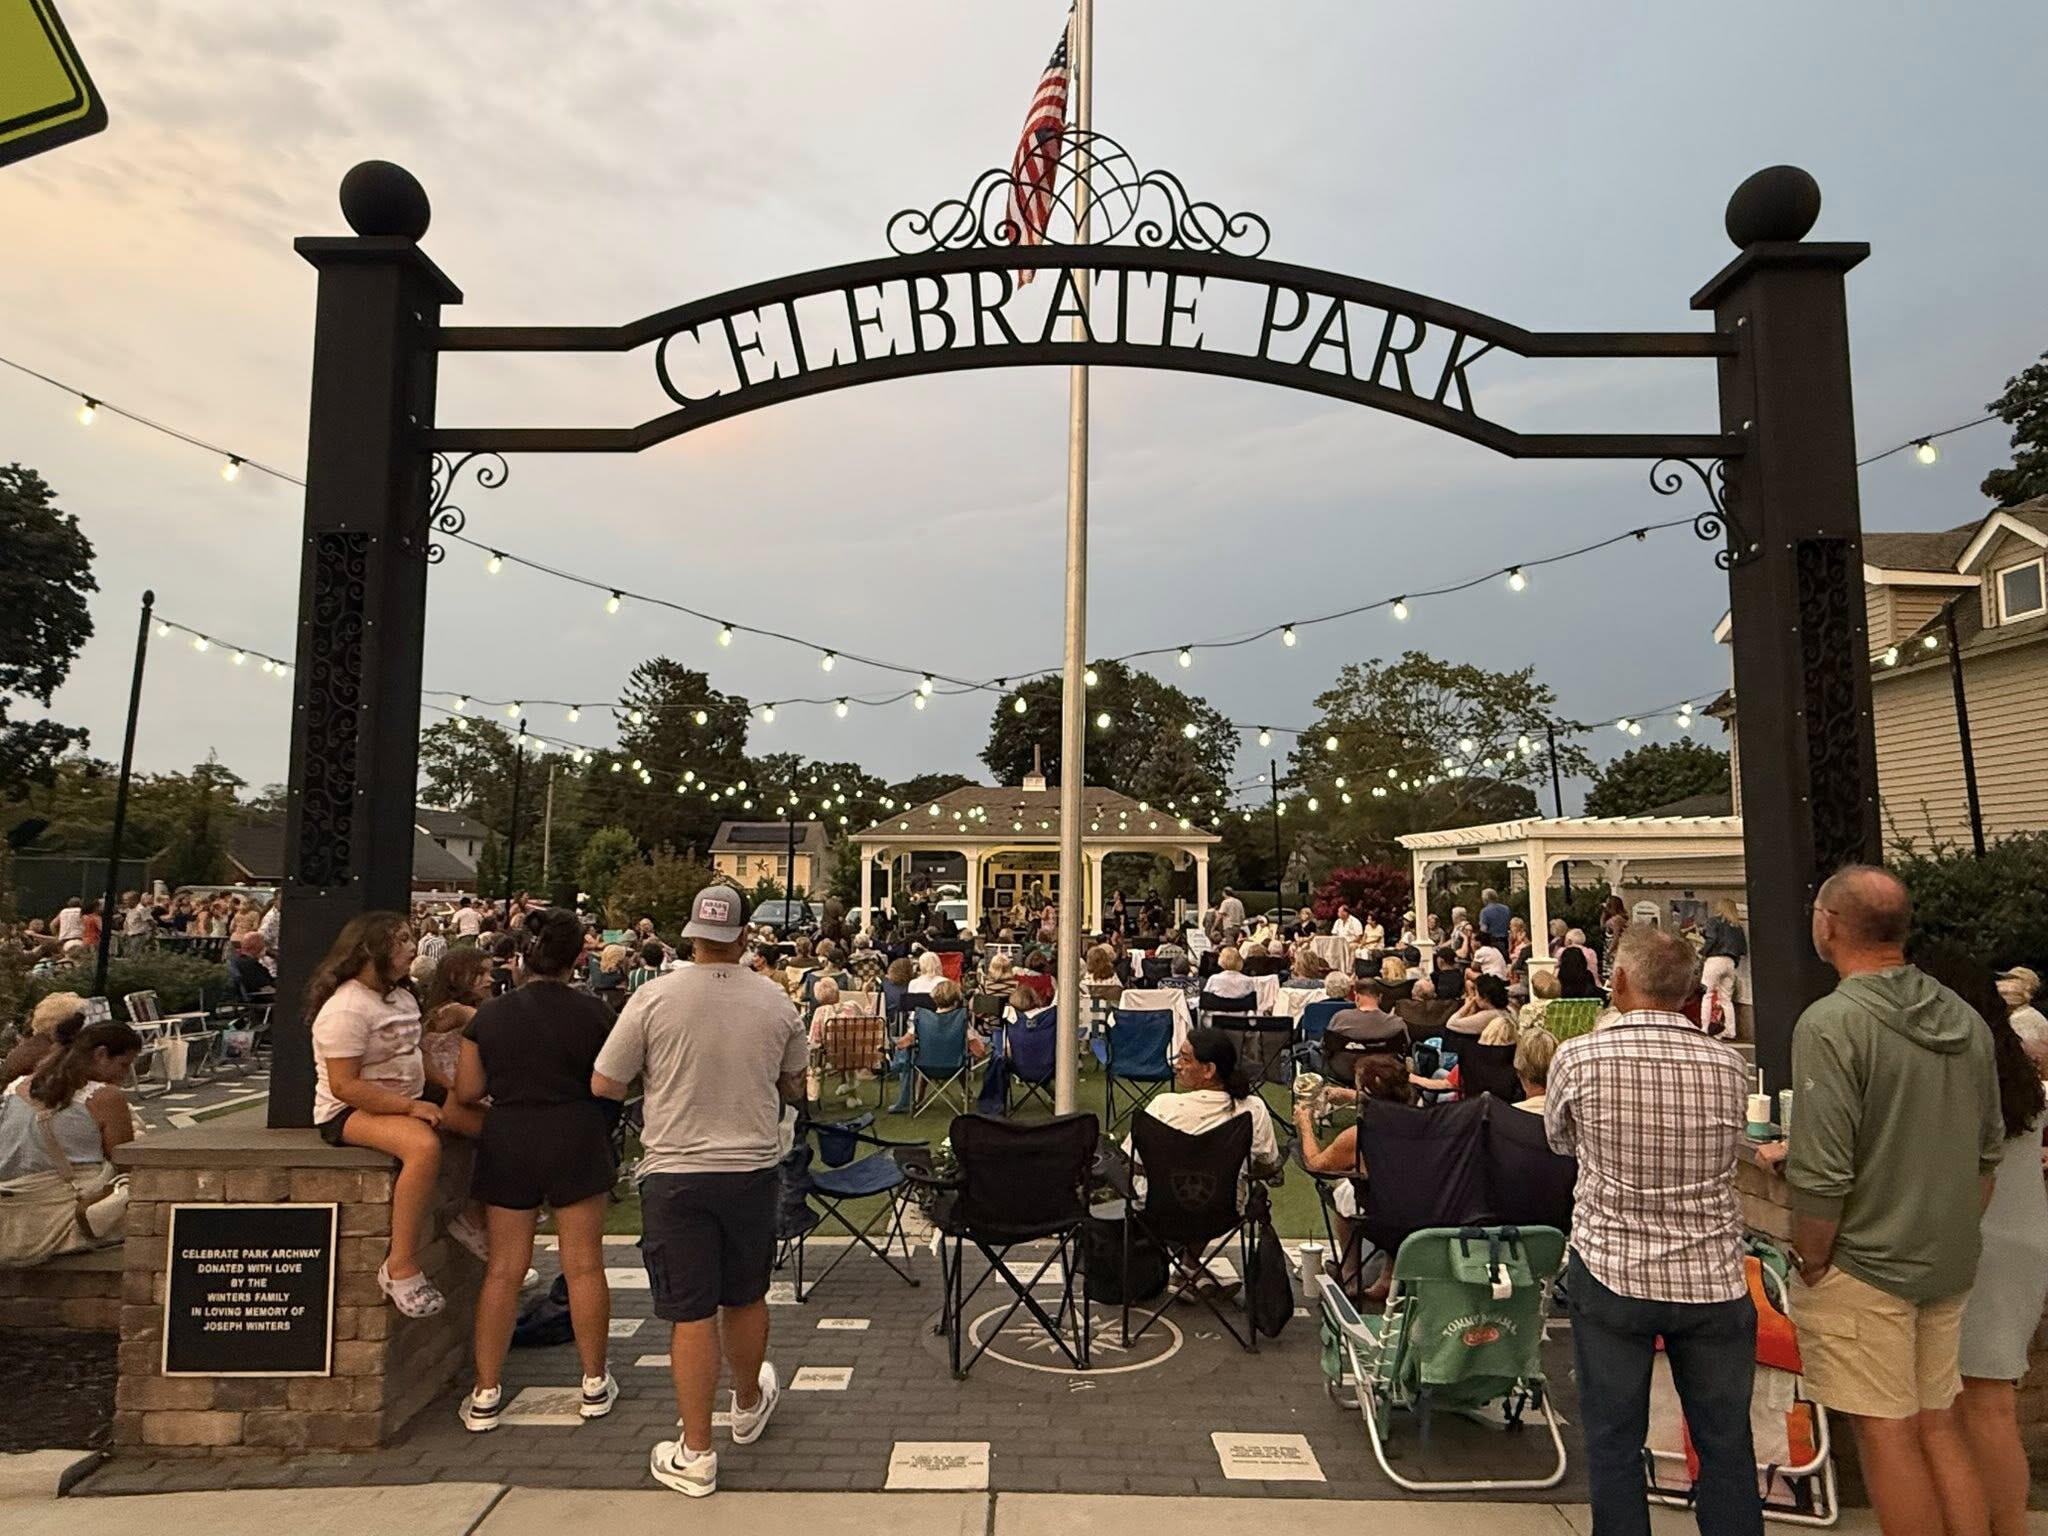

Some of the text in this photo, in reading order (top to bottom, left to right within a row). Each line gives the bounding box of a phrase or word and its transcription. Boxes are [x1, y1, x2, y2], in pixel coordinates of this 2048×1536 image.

[656, 267, 1498, 415] CELEBRATE PARK
[181, 1248, 321, 1260] CELEBRATE PARK ARCHWAY
[197, 1263, 302, 1274] DONATED WITH LOVE
[230, 1278, 268, 1288] BY THE
[207, 1292, 290, 1302] WINTERS FAMILY
[191, 1306, 306, 1317] IN LOVING MEMORY OF
[203, 1321, 291, 1332] JOSEPH WINTERS
